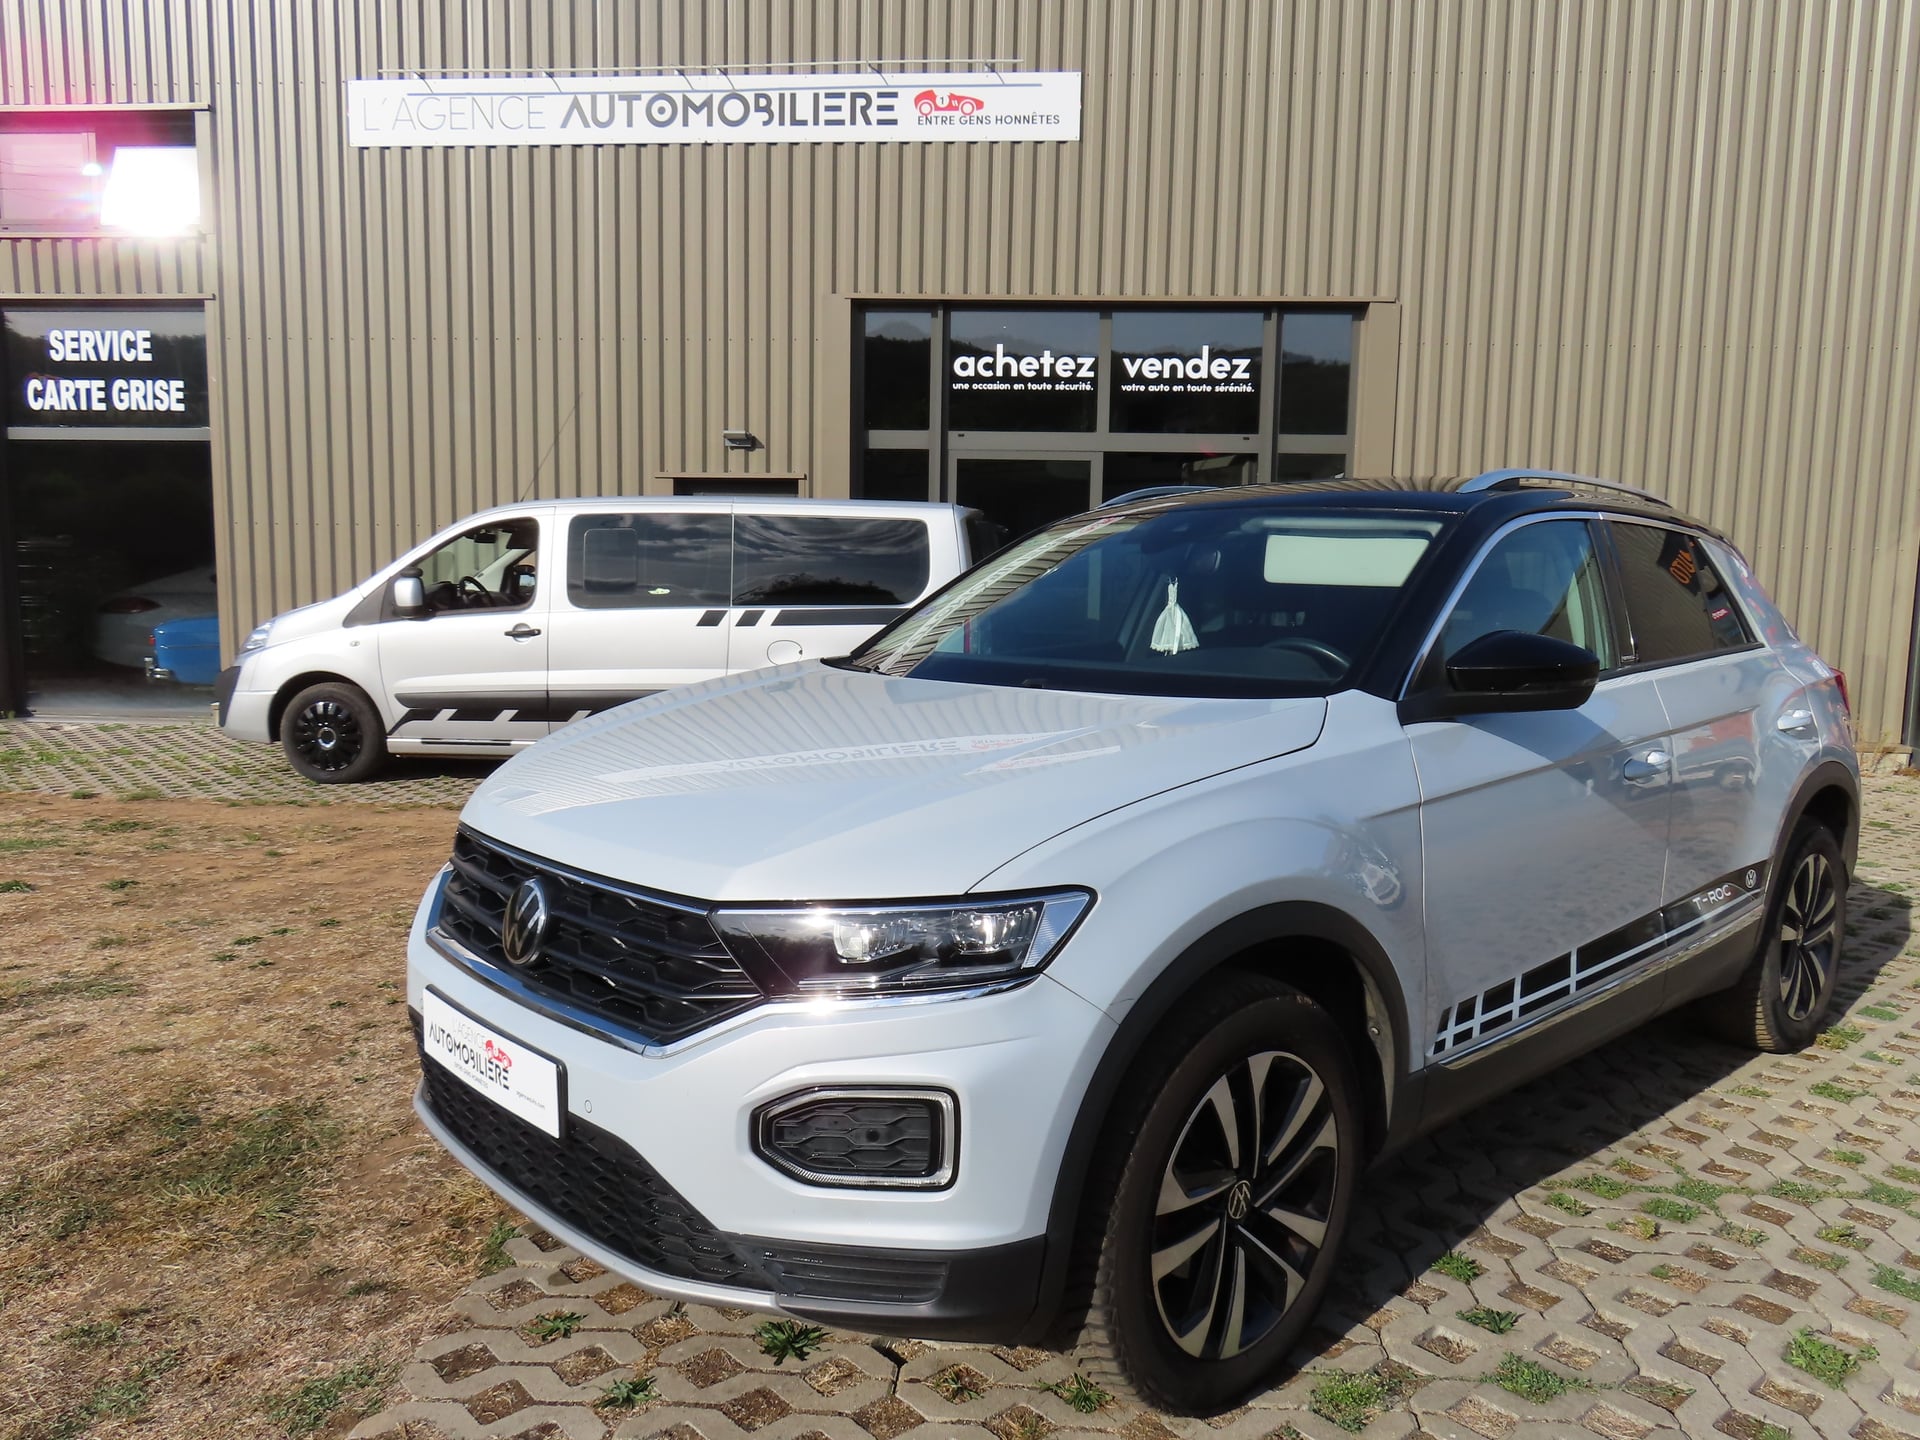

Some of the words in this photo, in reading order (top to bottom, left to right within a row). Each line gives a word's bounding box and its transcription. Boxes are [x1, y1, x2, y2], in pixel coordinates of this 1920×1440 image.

[362, 95, 547, 132] L'AGENCE
[559, 91, 900, 129] AUTOMOBILIERE
[917, 115, 956, 126] ENTRE
[958, 115, 992, 126] GENS
[994, 111, 1061, 126] HONNÊTES
[49, 329, 153, 362] SERVICE
[953, 343, 1096, 378] achetez
[1122, 345, 1252, 380] vendez
[27, 378, 107, 412] CARTE
[111, 378, 186, 412] GRISE
[952, 381, 970, 390] une
[972, 380, 1011, 391] occasion
[1013, 382, 1025, 390] en
[1027, 381, 1051, 391] toute
[1054, 380, 1094, 392] sécurité.
[1120, 383, 1146, 392] votre
[1147, 383, 1170, 392] auto
[1173, 383, 1184, 392] en
[1186, 383, 1212, 392] toute
[1214, 382, 1255, 393] sérénité.
[1692, 884, 1732, 911] T-ROC
[428, 1023, 510, 1090] AUTOMOBILIERE
